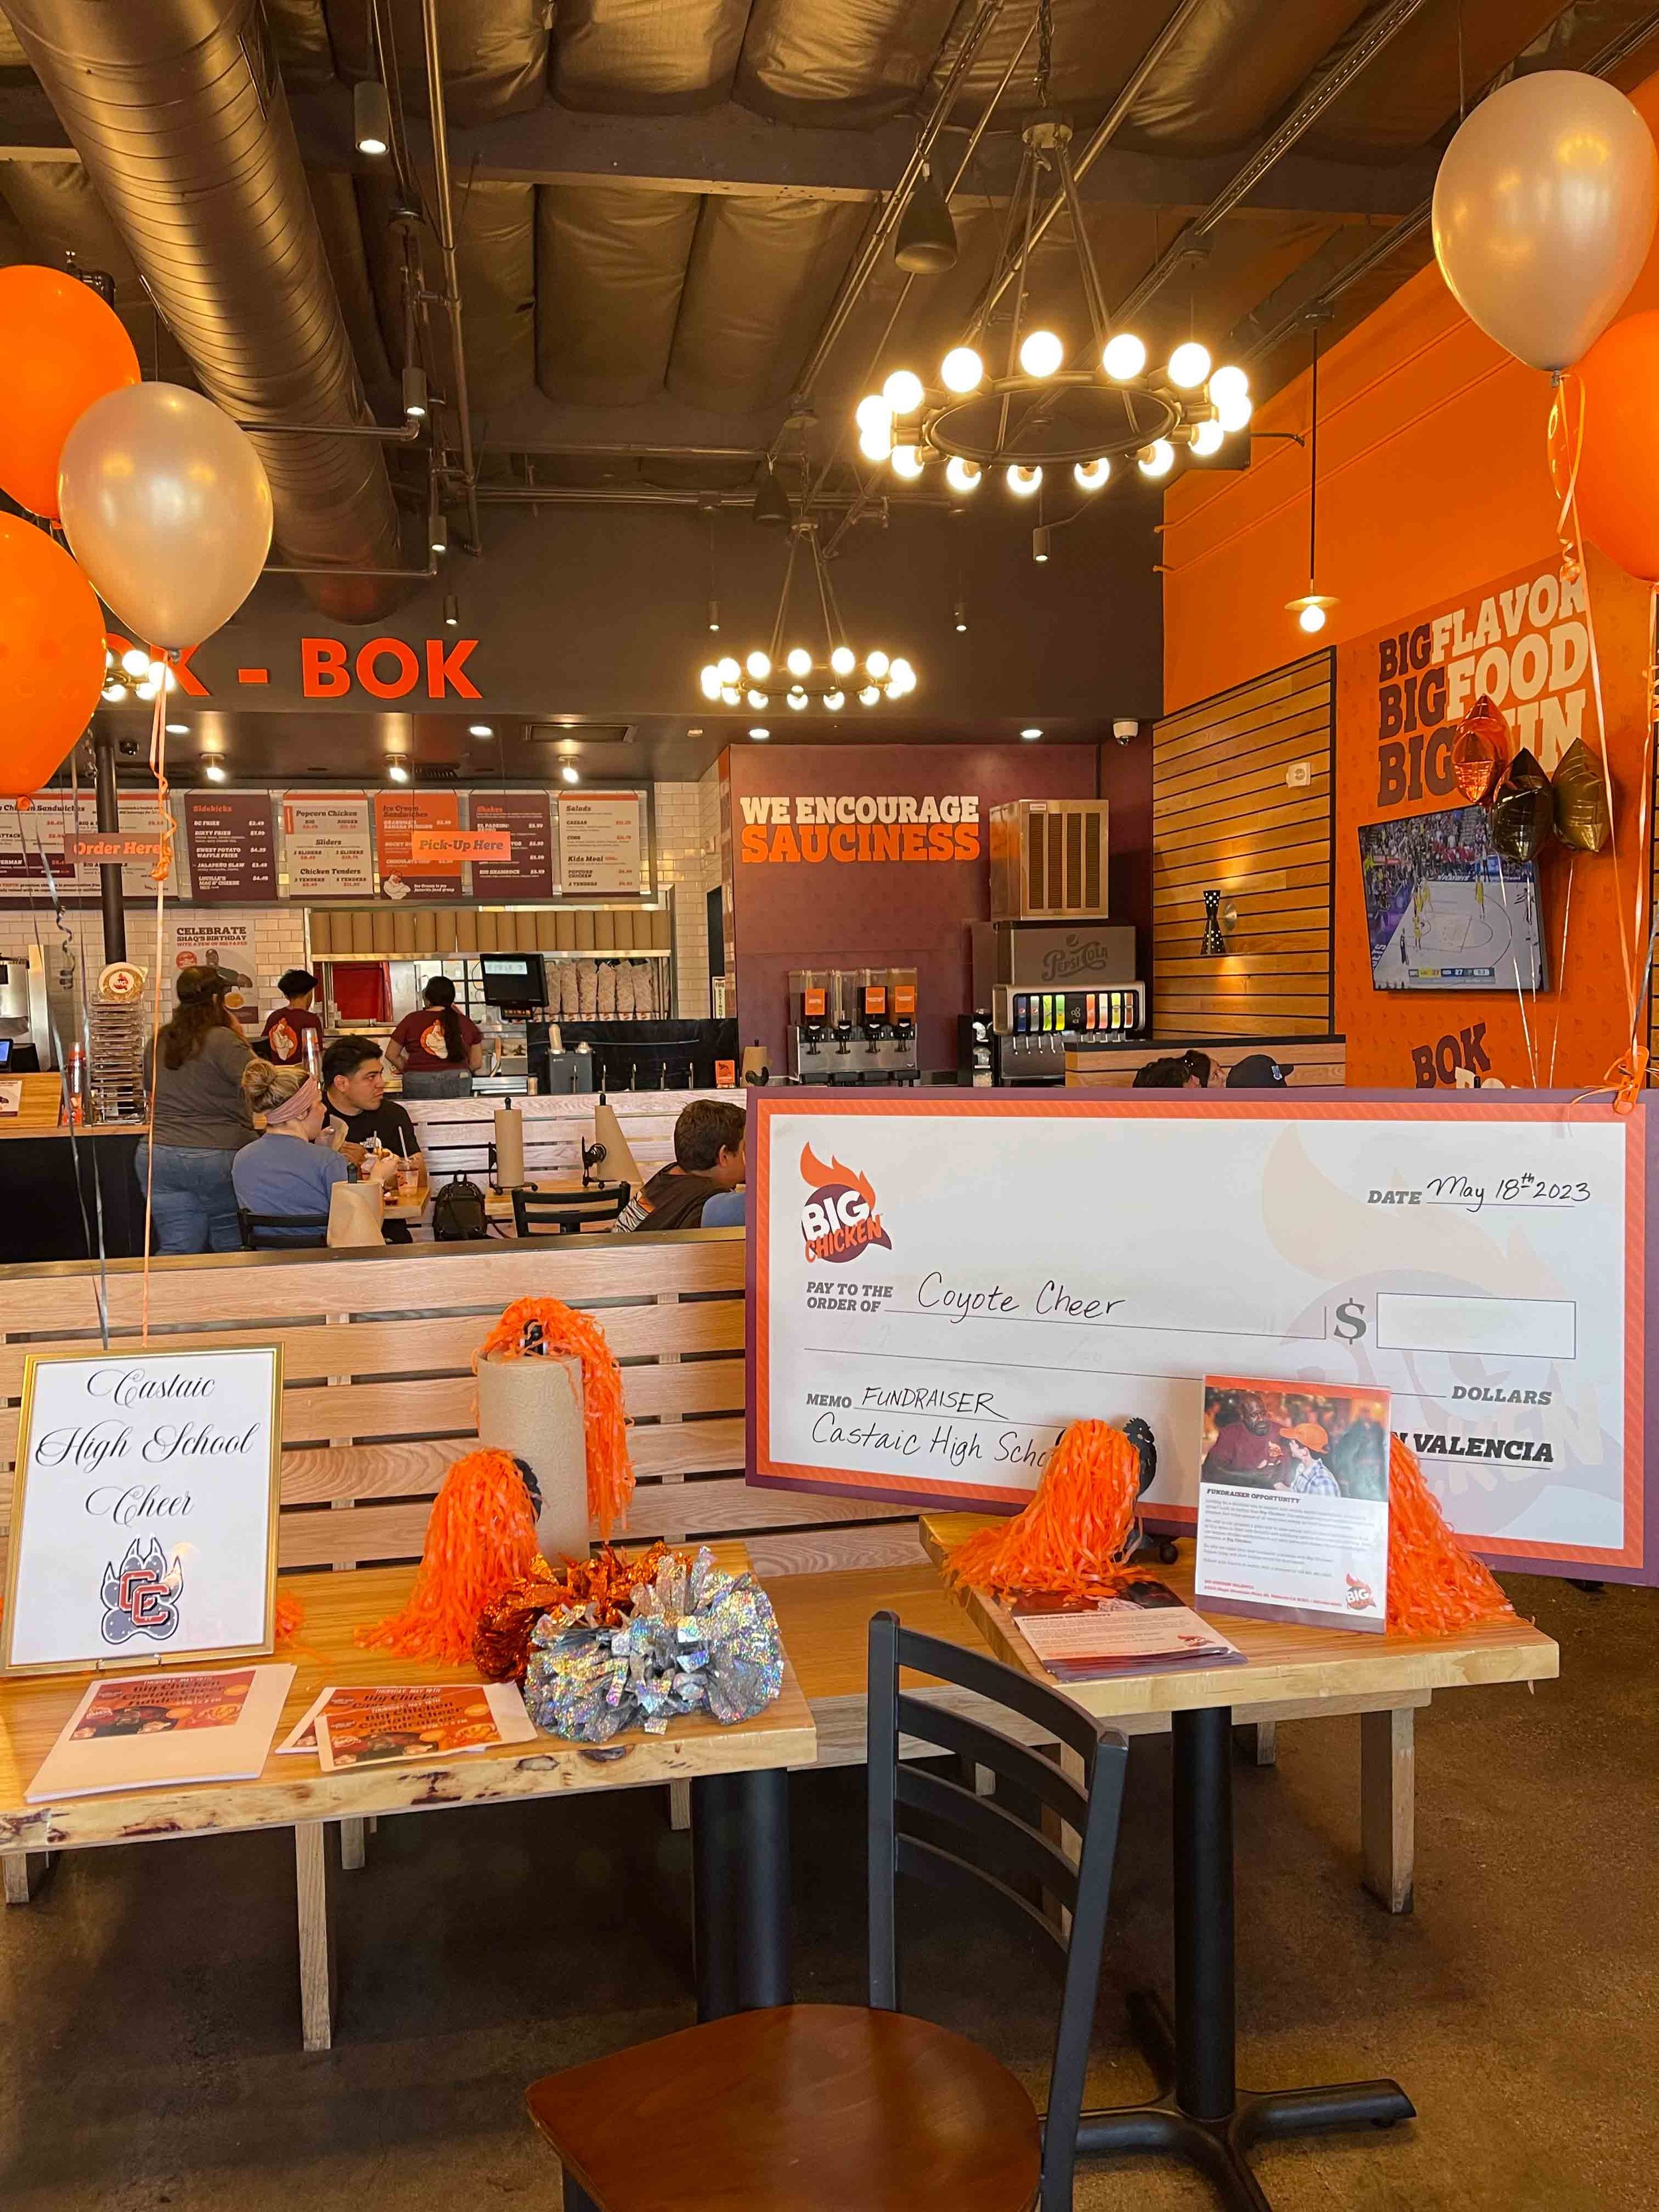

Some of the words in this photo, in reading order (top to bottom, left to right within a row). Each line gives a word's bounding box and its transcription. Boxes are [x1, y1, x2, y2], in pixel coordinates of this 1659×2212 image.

[1379, 623, 1431, 683] BIG
[1431, 574, 1587, 663] FLAVOR
[301, 637, 483, 699] BOK
[1379, 666, 1447, 741] BIG
[1447, 622, 1589, 721] FOOD
[1378, 725, 1458, 807] BIG
[1502, 689, 1587, 774] UN
[740, 796, 790, 824] WE
[796, 795, 979, 824] ENCOURAGE
[74, 841, 121, 855] Order
[123, 841, 161, 855] Here
[419, 840, 470, 851] Pick-Up
[473, 840, 504, 850] Here
[741, 823, 980, 863] SAUCINESS
[177, 926, 246, 935] CELEBRATE
[1411, 1023, 1492, 1088] BOK
[1367, 1190, 1422, 1206] DATE
[1427, 1175, 1485, 1213] May
[1533, 1181, 1591, 1202] 2023
[801, 1190, 871, 1240] BIG
[804, 1214, 883, 1263] CHICKEN
[806, 1282, 835, 1296] PAY
[837, 1283, 858, 1297] TO
[862, 1285, 893, 1299] THE
[806, 1297, 857, 1312] ORDER
[860, 1299, 881, 1313] OF
[918, 1272, 1020, 1324] Coyote
[1035, 1280, 1126, 1319] Cheer
[1333, 1297, 1367, 1345] $
[87, 1368, 216, 1408] Castaic
[806, 1394, 852, 1409] MEMO
[862, 1386, 1009, 1420] FUNDRAISER
[1451, 1386, 1552, 1406] DOLLARS
[35, 1419, 134, 1473] High
[142, 1422, 261, 1463] School
[812, 1412, 922, 1453] Castaic
[929, 1426, 983, 1466] High
[994, 1431, 1047, 1468] Scho
[1413, 1434, 1554, 1463] VALENCIA
[86, 1484, 194, 1527] Cheer
[1206, 1489, 1250, 1498] FUNDRAISER
[1251, 1493, 1301, 1504] OPPORTUNITY
[1346, 1588, 1370, 1603] BIG
